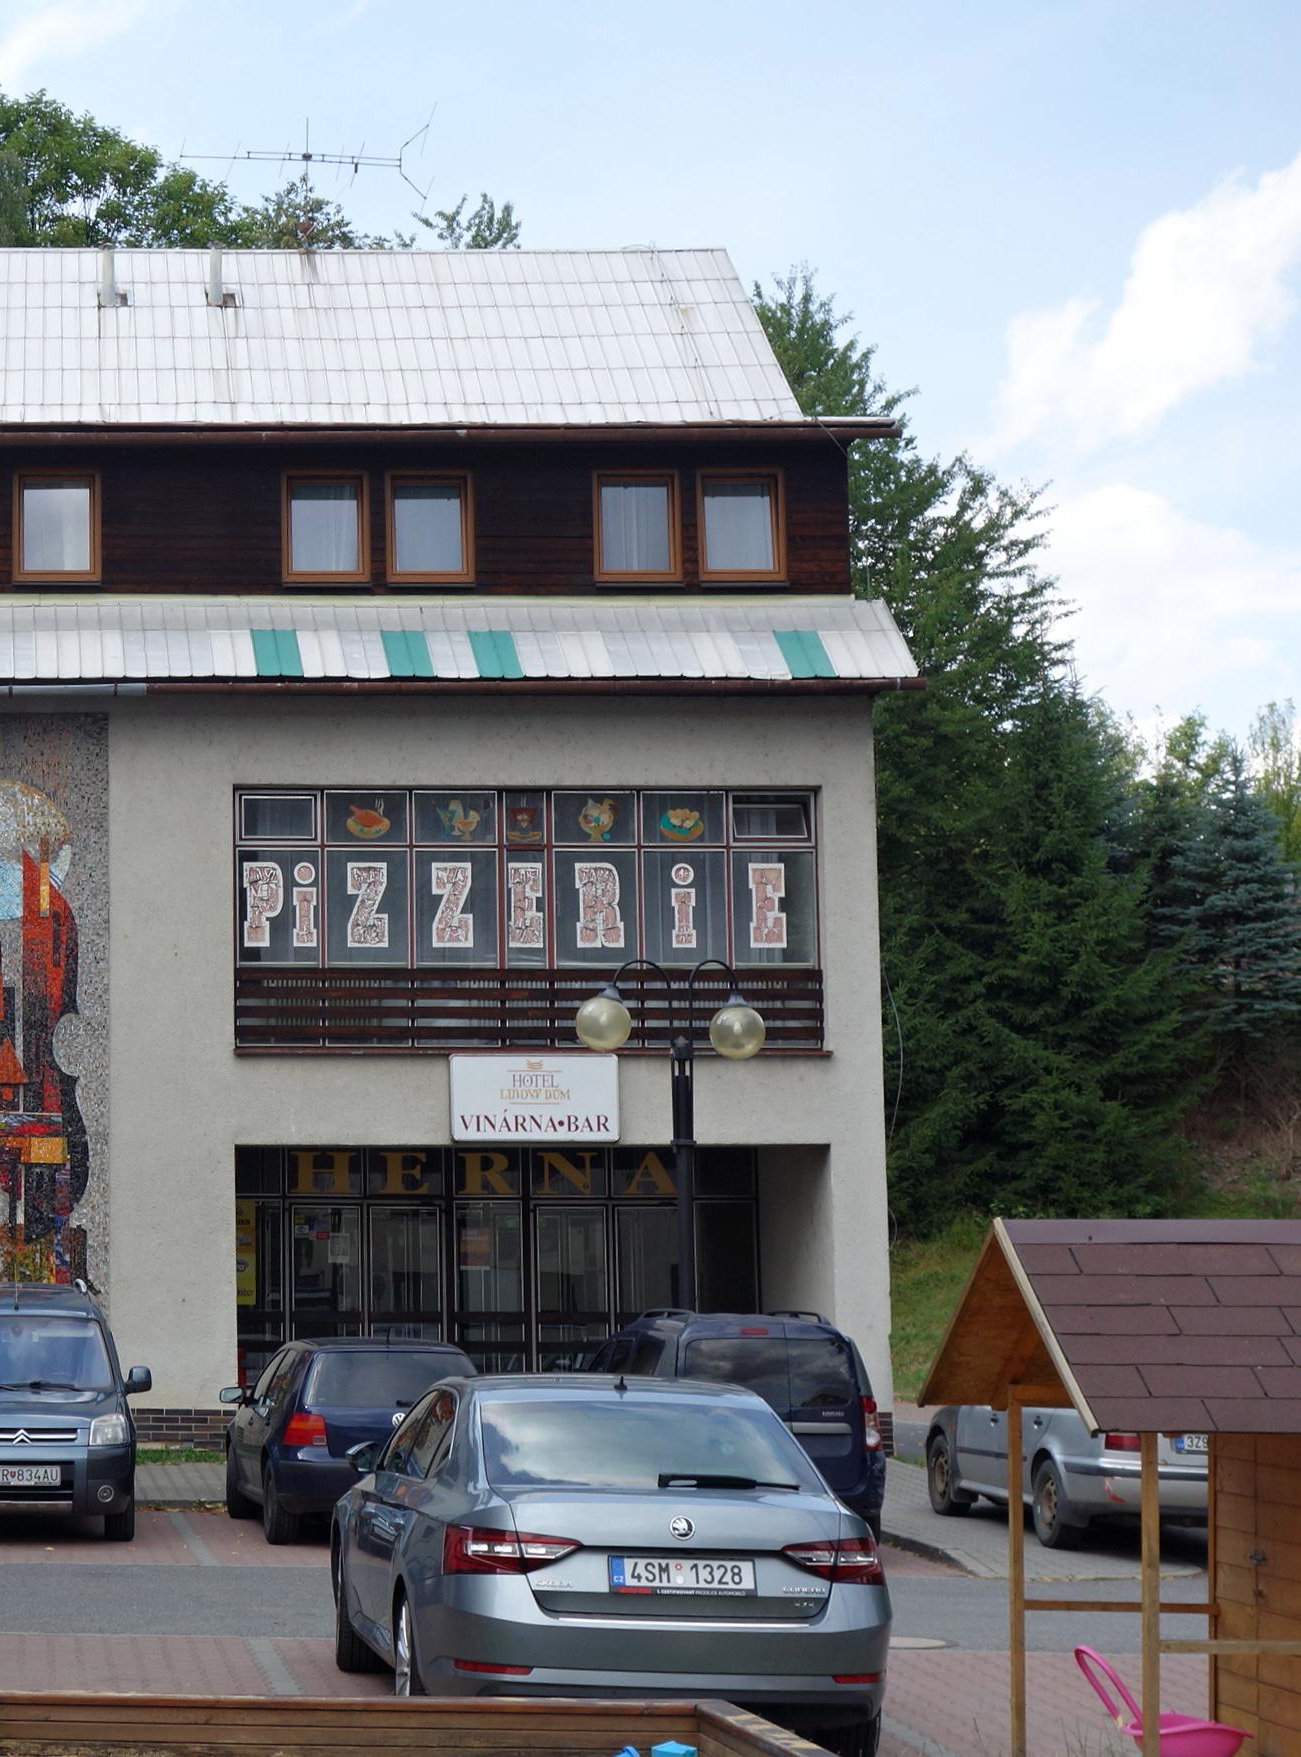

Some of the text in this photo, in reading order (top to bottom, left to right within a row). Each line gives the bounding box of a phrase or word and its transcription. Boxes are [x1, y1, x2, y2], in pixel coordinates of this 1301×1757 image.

[511, 1073, 559, 1088] HOTEL
[290, 1151, 678, 1196] HERNA
[630, 1561, 744, 1586] 4SM 1328
